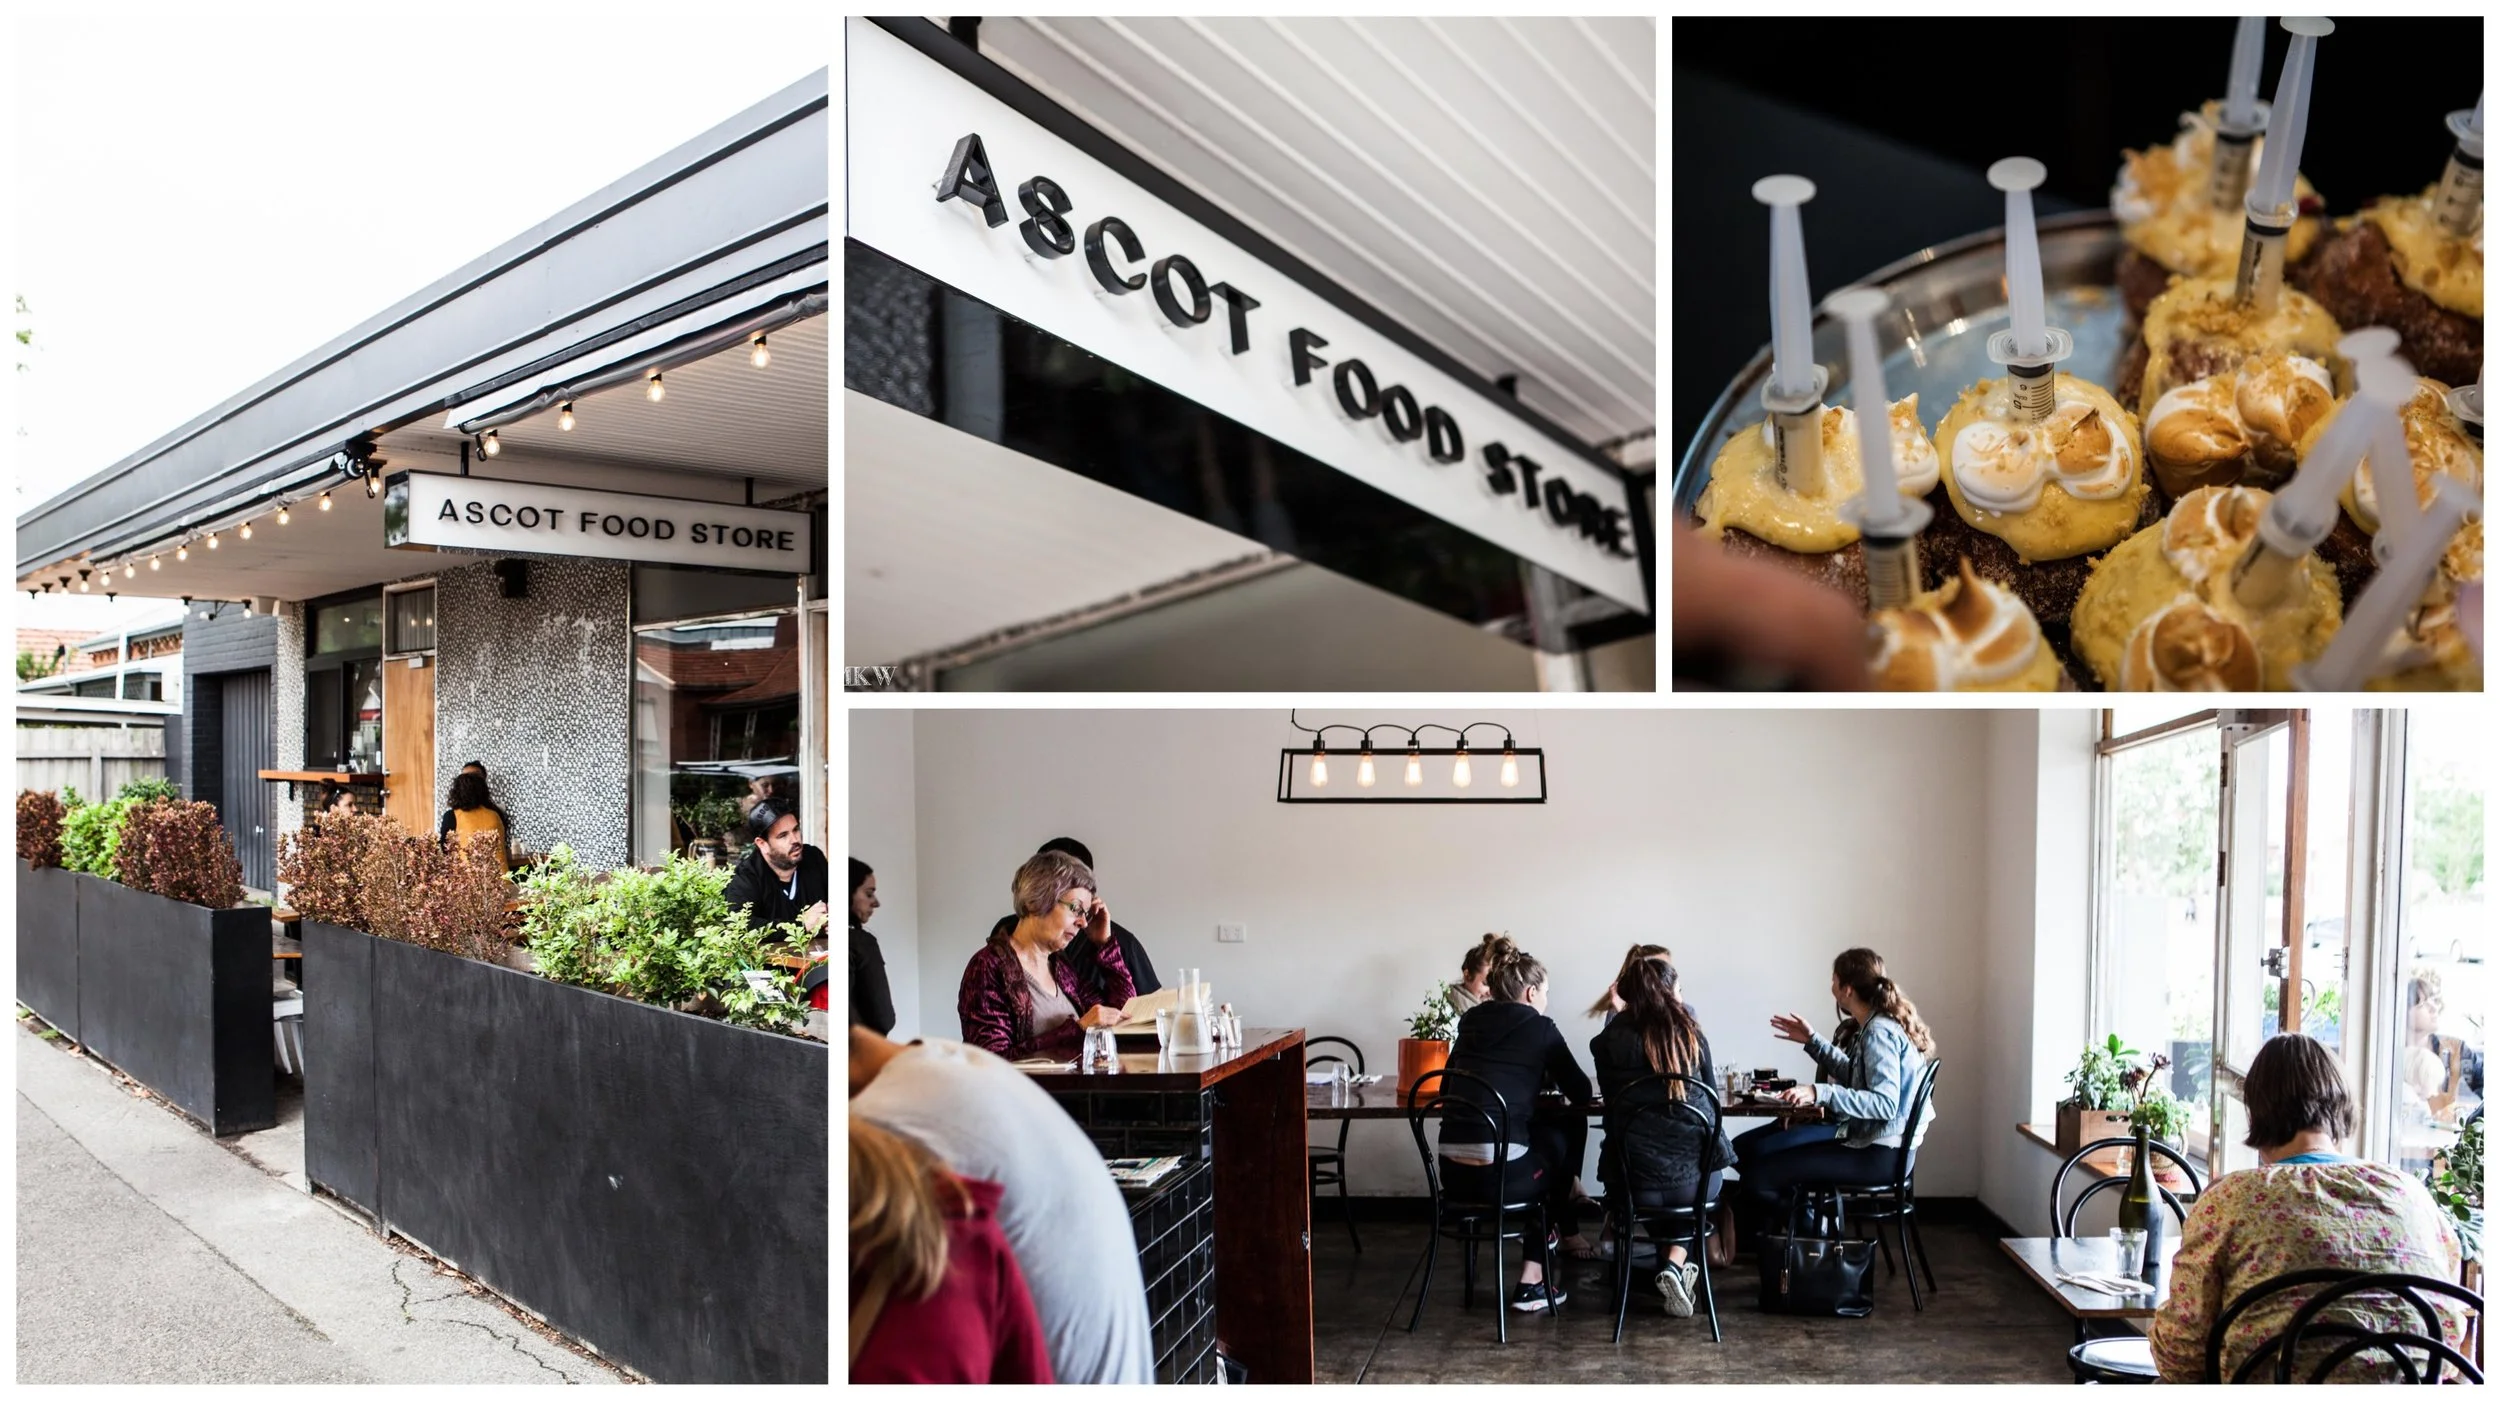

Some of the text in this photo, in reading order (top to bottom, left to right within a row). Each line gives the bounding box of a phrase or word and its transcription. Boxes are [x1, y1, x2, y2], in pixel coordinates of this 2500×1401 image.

[936, 133, 1637, 560] ASCOT FOOD STORE
[438, 498, 796, 552] ASCOT FOOD STORE
